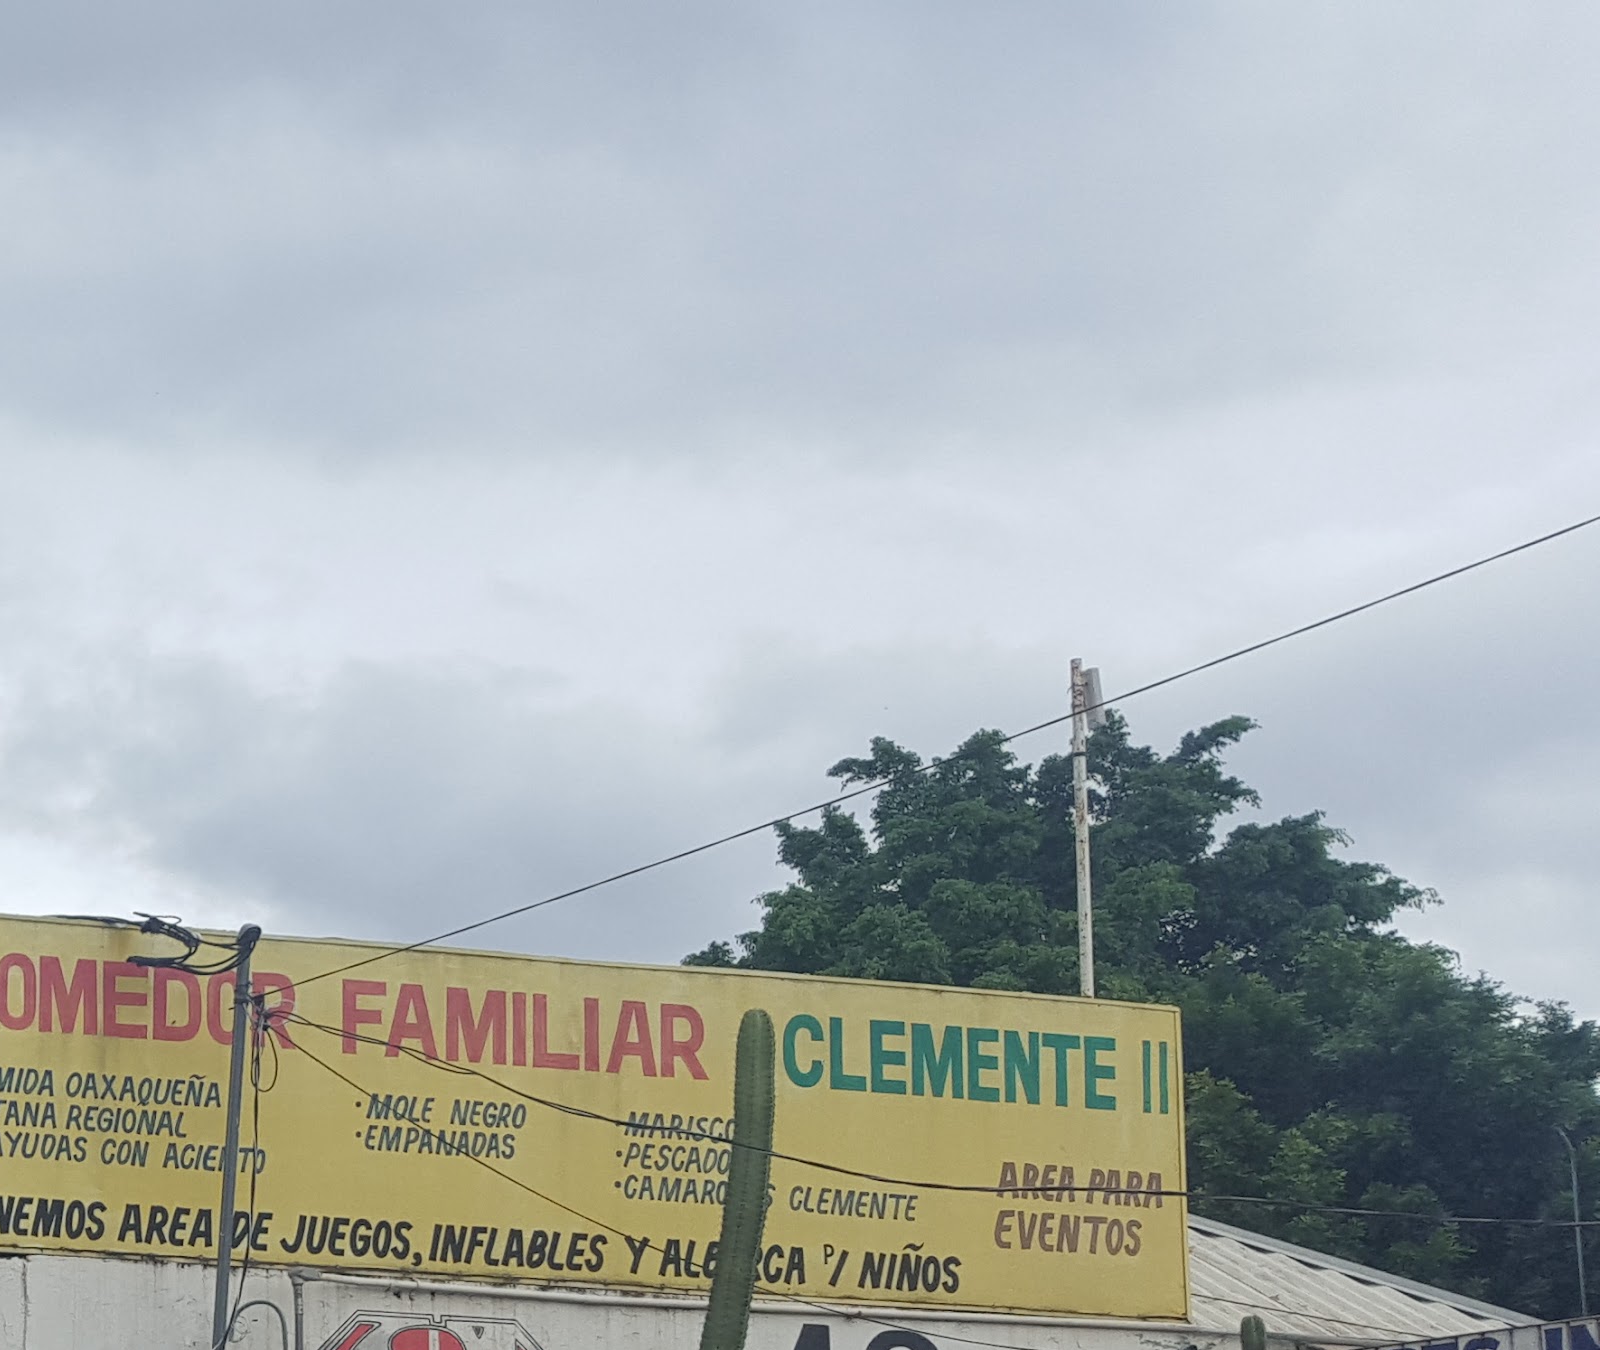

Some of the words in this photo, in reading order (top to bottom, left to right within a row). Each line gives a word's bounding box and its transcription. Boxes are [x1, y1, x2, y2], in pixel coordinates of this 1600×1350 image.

[341, 978, 709, 1081] FAMILIAR
[782, 1013, 1117, 1112] CLEMENTE
[1141, 1039, 1170, 1115] II
[64, 1072, 223, 1110] OAXAQUEÑA
[66, 1105, 188, 1139] REGIONAL
[365, 1093, 435, 1125] MOLE
[449, 1098, 527, 1130] NEGRO
[624, 1111, 736, 1145] MARISCO
[100, 1138, 148, 1168] CON
[363, 1124, 516, 1160] EMPANADAS
[623, 1142, 731, 1175] PESCADO
[623, 1174, 776, 1209] CAMAROS
[789, 1185, 919, 1222] CLEMENTE
[996, 1161, 1075, 1199] AREA
[1088, 1168, 1164, 1209] PARA
[117, 1203, 214, 1248] AREA
[231, 1210, 273, 1252] DE
[279, 1215, 424, 1267] JUEGOS,
[428, 1224, 608, 1273] INFLABLES
[624, 1236, 650, 1274] Y
[658, 1238, 806, 1285] ALBCA
[857, 1242, 961, 1294] NIÑOS
[994, 1209, 1144, 1257] EVENTOS
